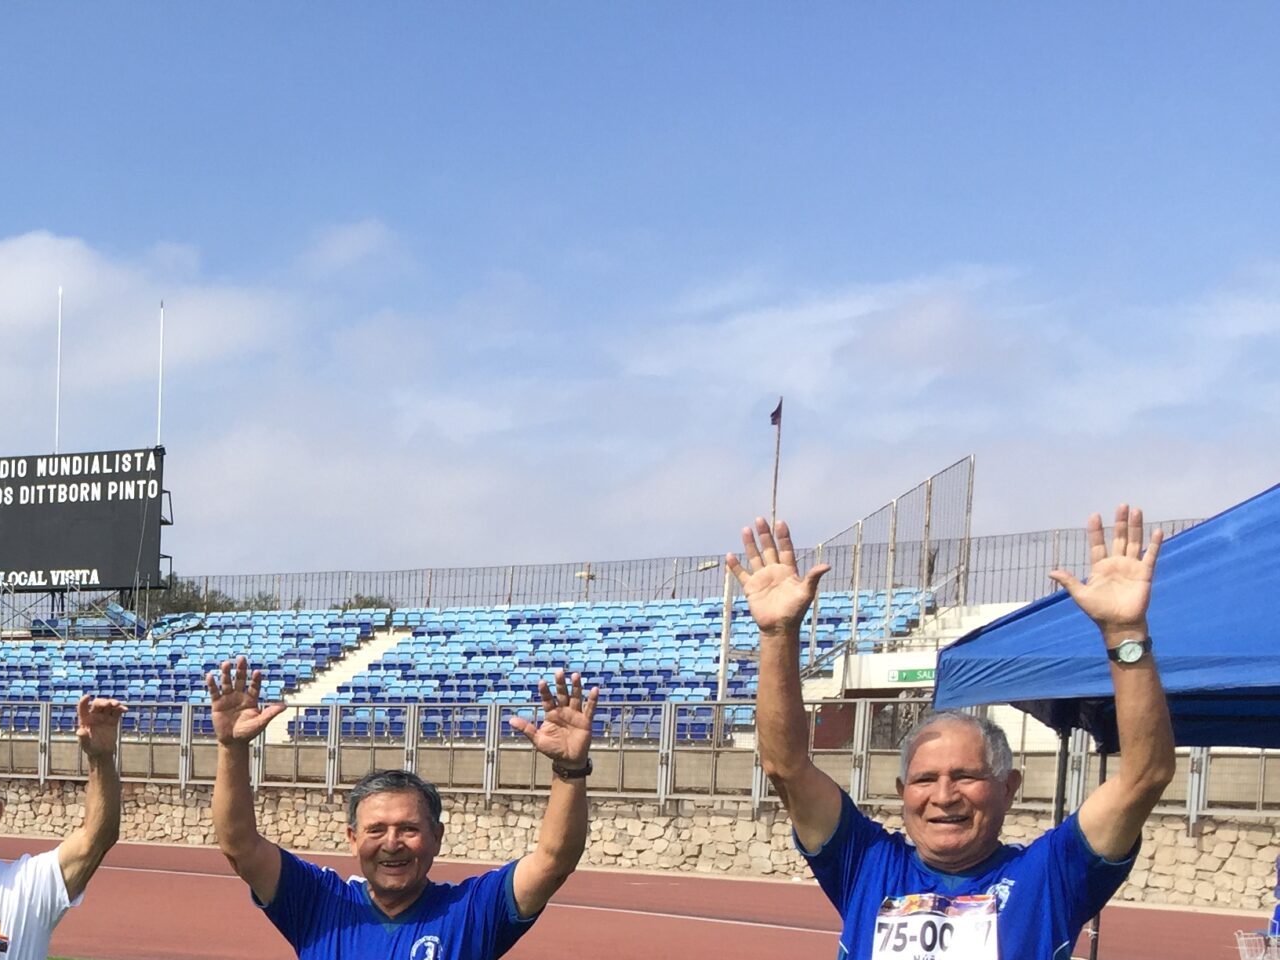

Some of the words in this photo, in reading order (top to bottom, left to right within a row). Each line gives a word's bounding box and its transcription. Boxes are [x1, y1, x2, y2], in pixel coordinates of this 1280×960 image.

[36, 451, 157, 477] MUNDIALISTA
[20, 481, 102, 505] DITTBORN
[107, 479, 158, 501] PINTO
[0, 569, 48, 587] LOCAL
[49, 568, 100, 586] VISITA
[916, 670, 935, 679] SALI
[877, 920, 992, 952] 75-007
